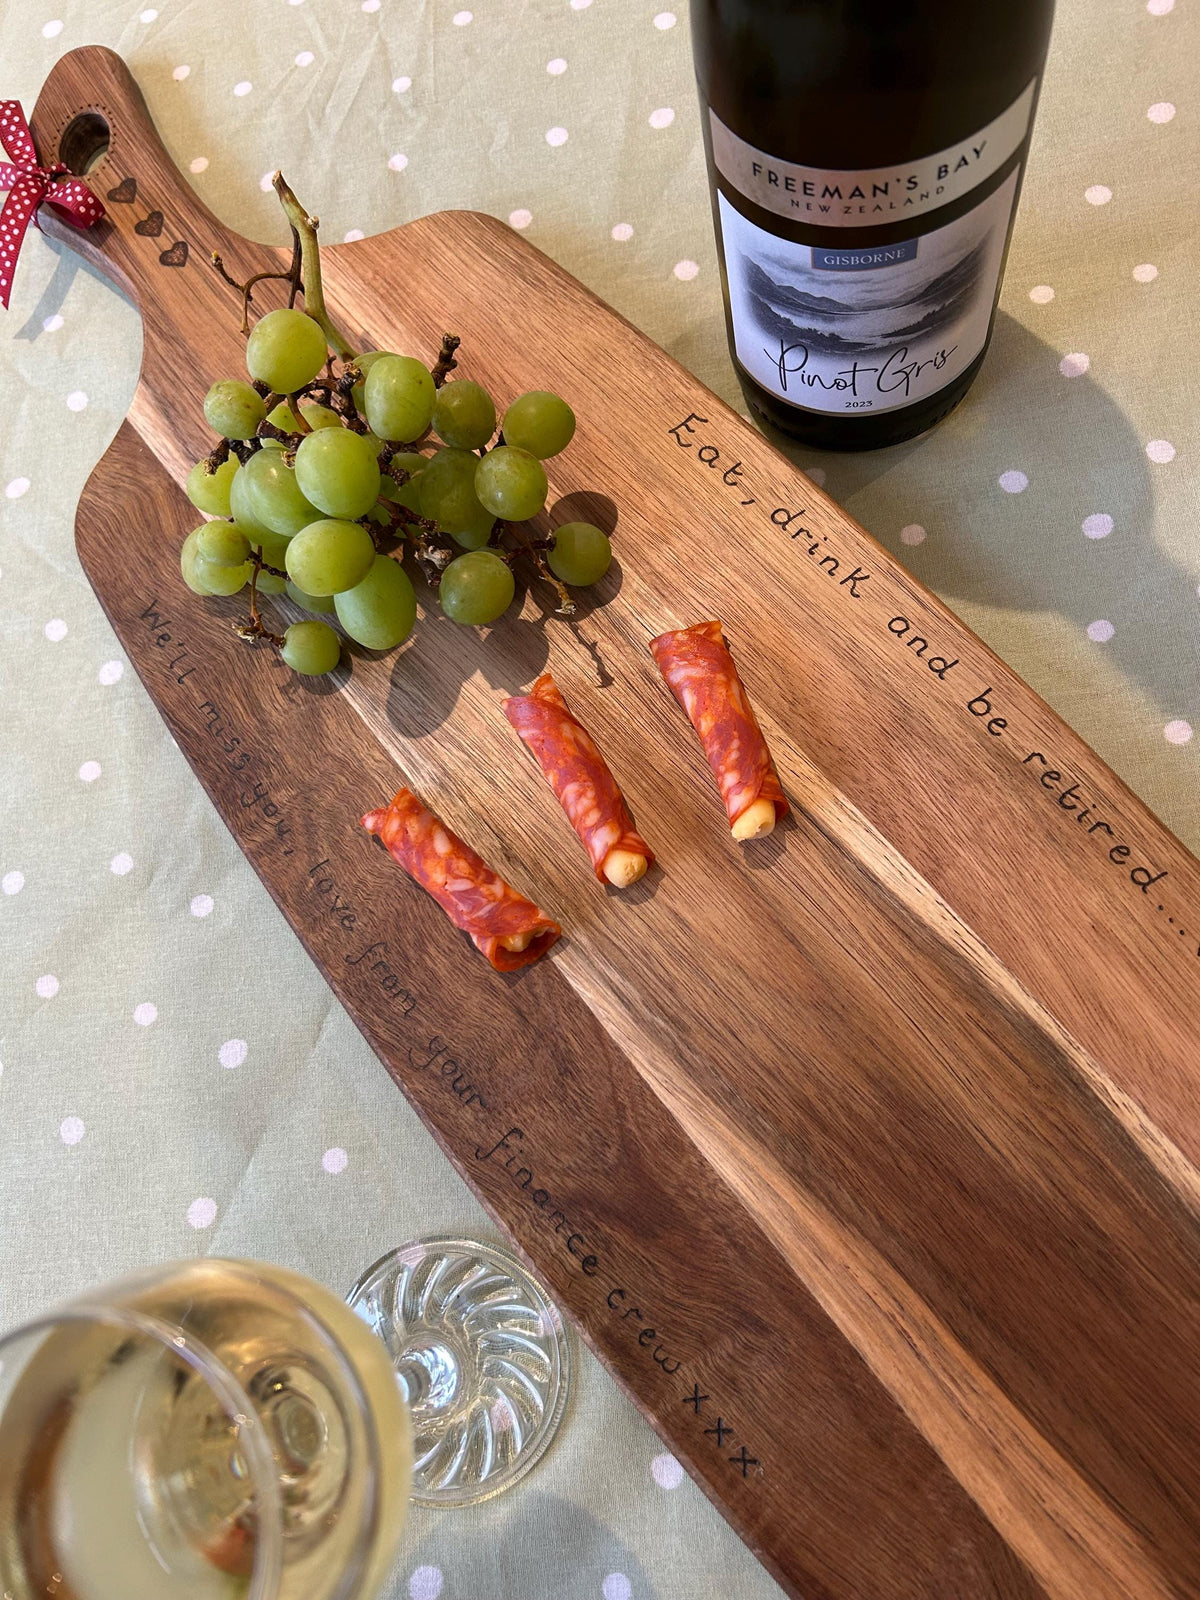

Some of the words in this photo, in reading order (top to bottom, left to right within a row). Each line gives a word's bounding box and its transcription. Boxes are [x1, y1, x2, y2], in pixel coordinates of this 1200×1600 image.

[752, 162, 919, 200] FREEMAN'S
[936, 140, 987, 181] BAY
[790, 199, 831, 214] NEW
[843, 186, 945, 215] ZEALAND
[823, 248, 906, 266] GISBORNE
[763, 339, 878, 396] Pinot
[876, 345, 958, 396] Gris
[844, 400, 873, 408] 2023
[667, 412, 756, 506] Eat,
[887, 615, 960, 681] and
[967, 687, 1008, 737] be
[139, 599, 197, 685] We'll
[199, 700, 251, 771] miss
[240, 782, 294, 856] you,
[308, 858, 356, 932] love
[344, 940, 417, 1017] from
[408, 1034, 488, 1110] your
[474, 1127, 599, 1278] finance
[606, 1288, 681, 1375] crew
